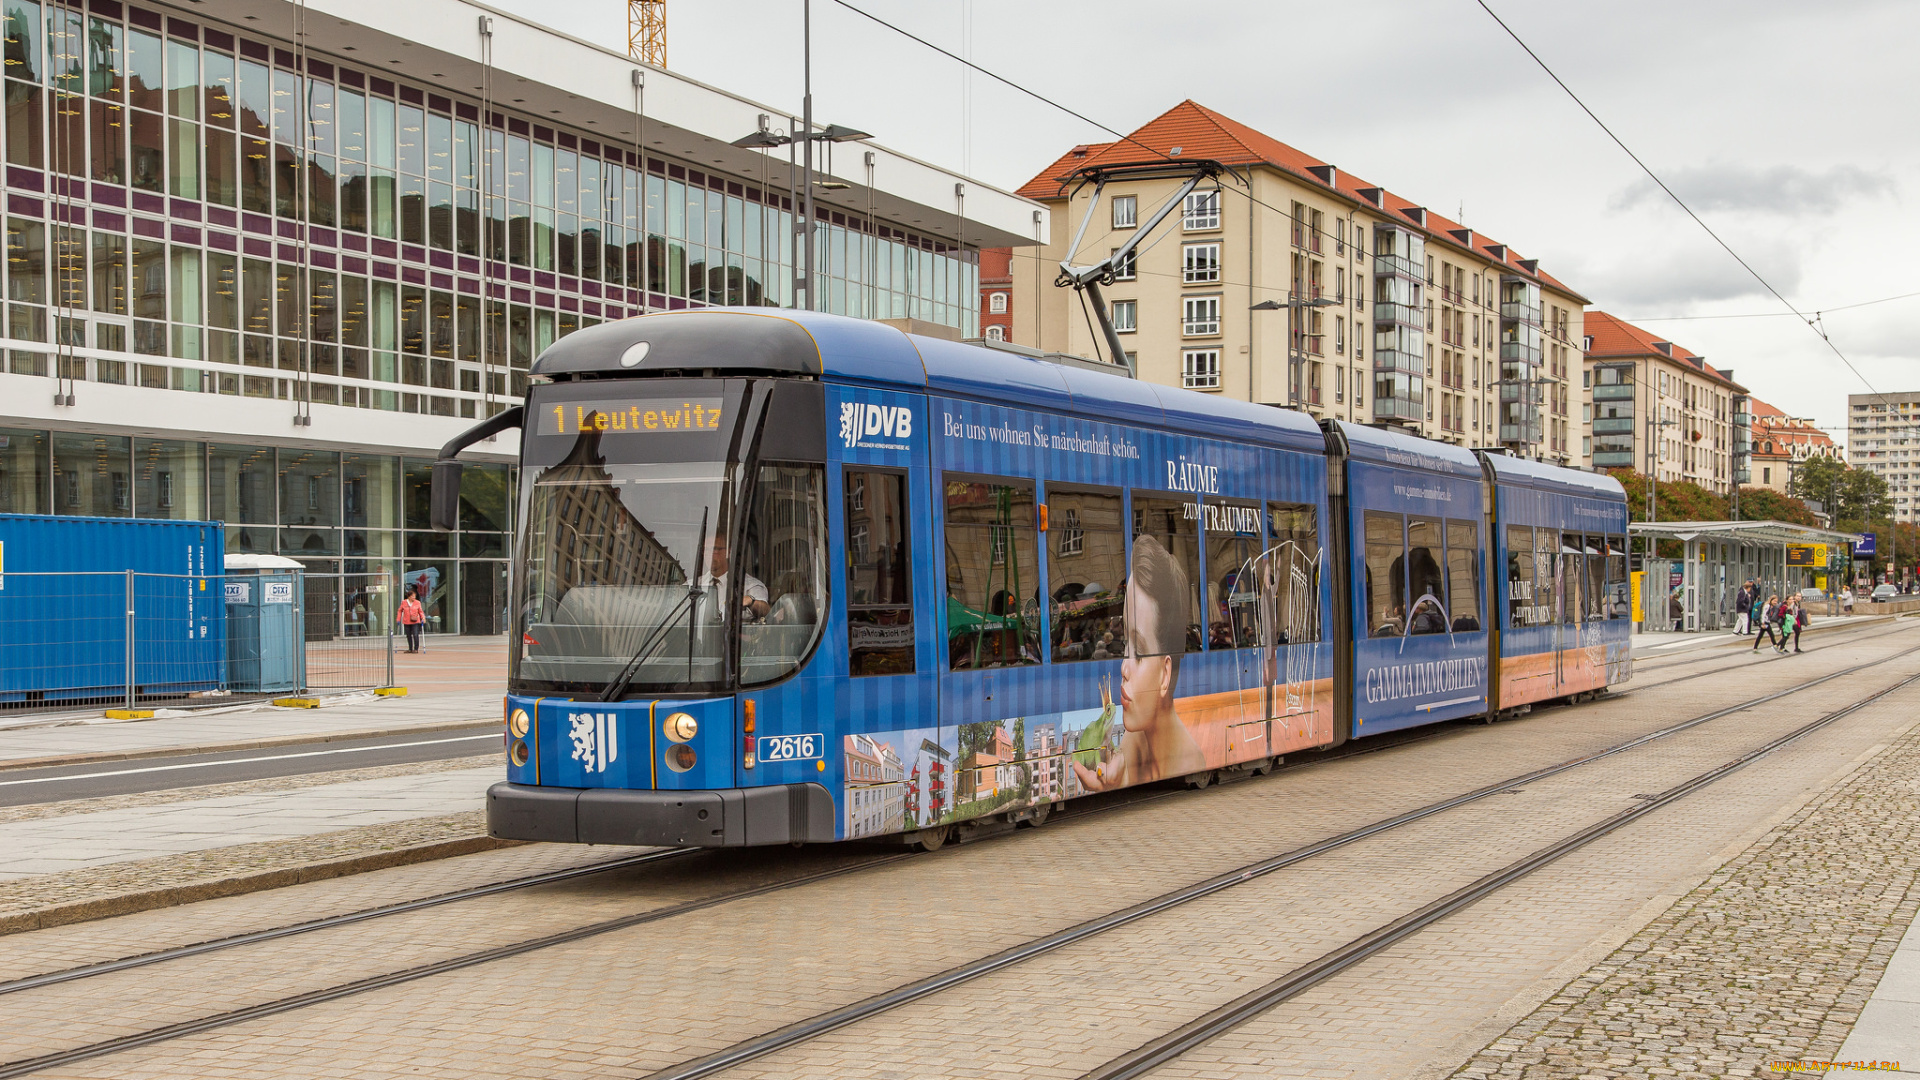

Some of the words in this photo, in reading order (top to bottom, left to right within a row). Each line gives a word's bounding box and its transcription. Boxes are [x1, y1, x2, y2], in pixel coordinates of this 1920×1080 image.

[553, 405, 565, 433] 1
[577, 403, 722, 432] Leutewitz
[865, 404, 912, 438] DVB
[943, 412, 964, 438] Bei
[965, 422, 986, 441] uns
[988, 422, 1031, 446] wohnen
[1033, 424, 1049, 448] Sie
[1051, 428, 1110, 456] märchenhaft
[1112, 438, 1140, 460] schön.
[1167, 456, 1220, 494] RÄUME
[1182, 502, 1202, 520] ZUM
[1202, 501, 1262, 534] TRÄUMEN
[1508, 576, 1532, 600] RÄUME
[769, 736, 814, 760] 2616
